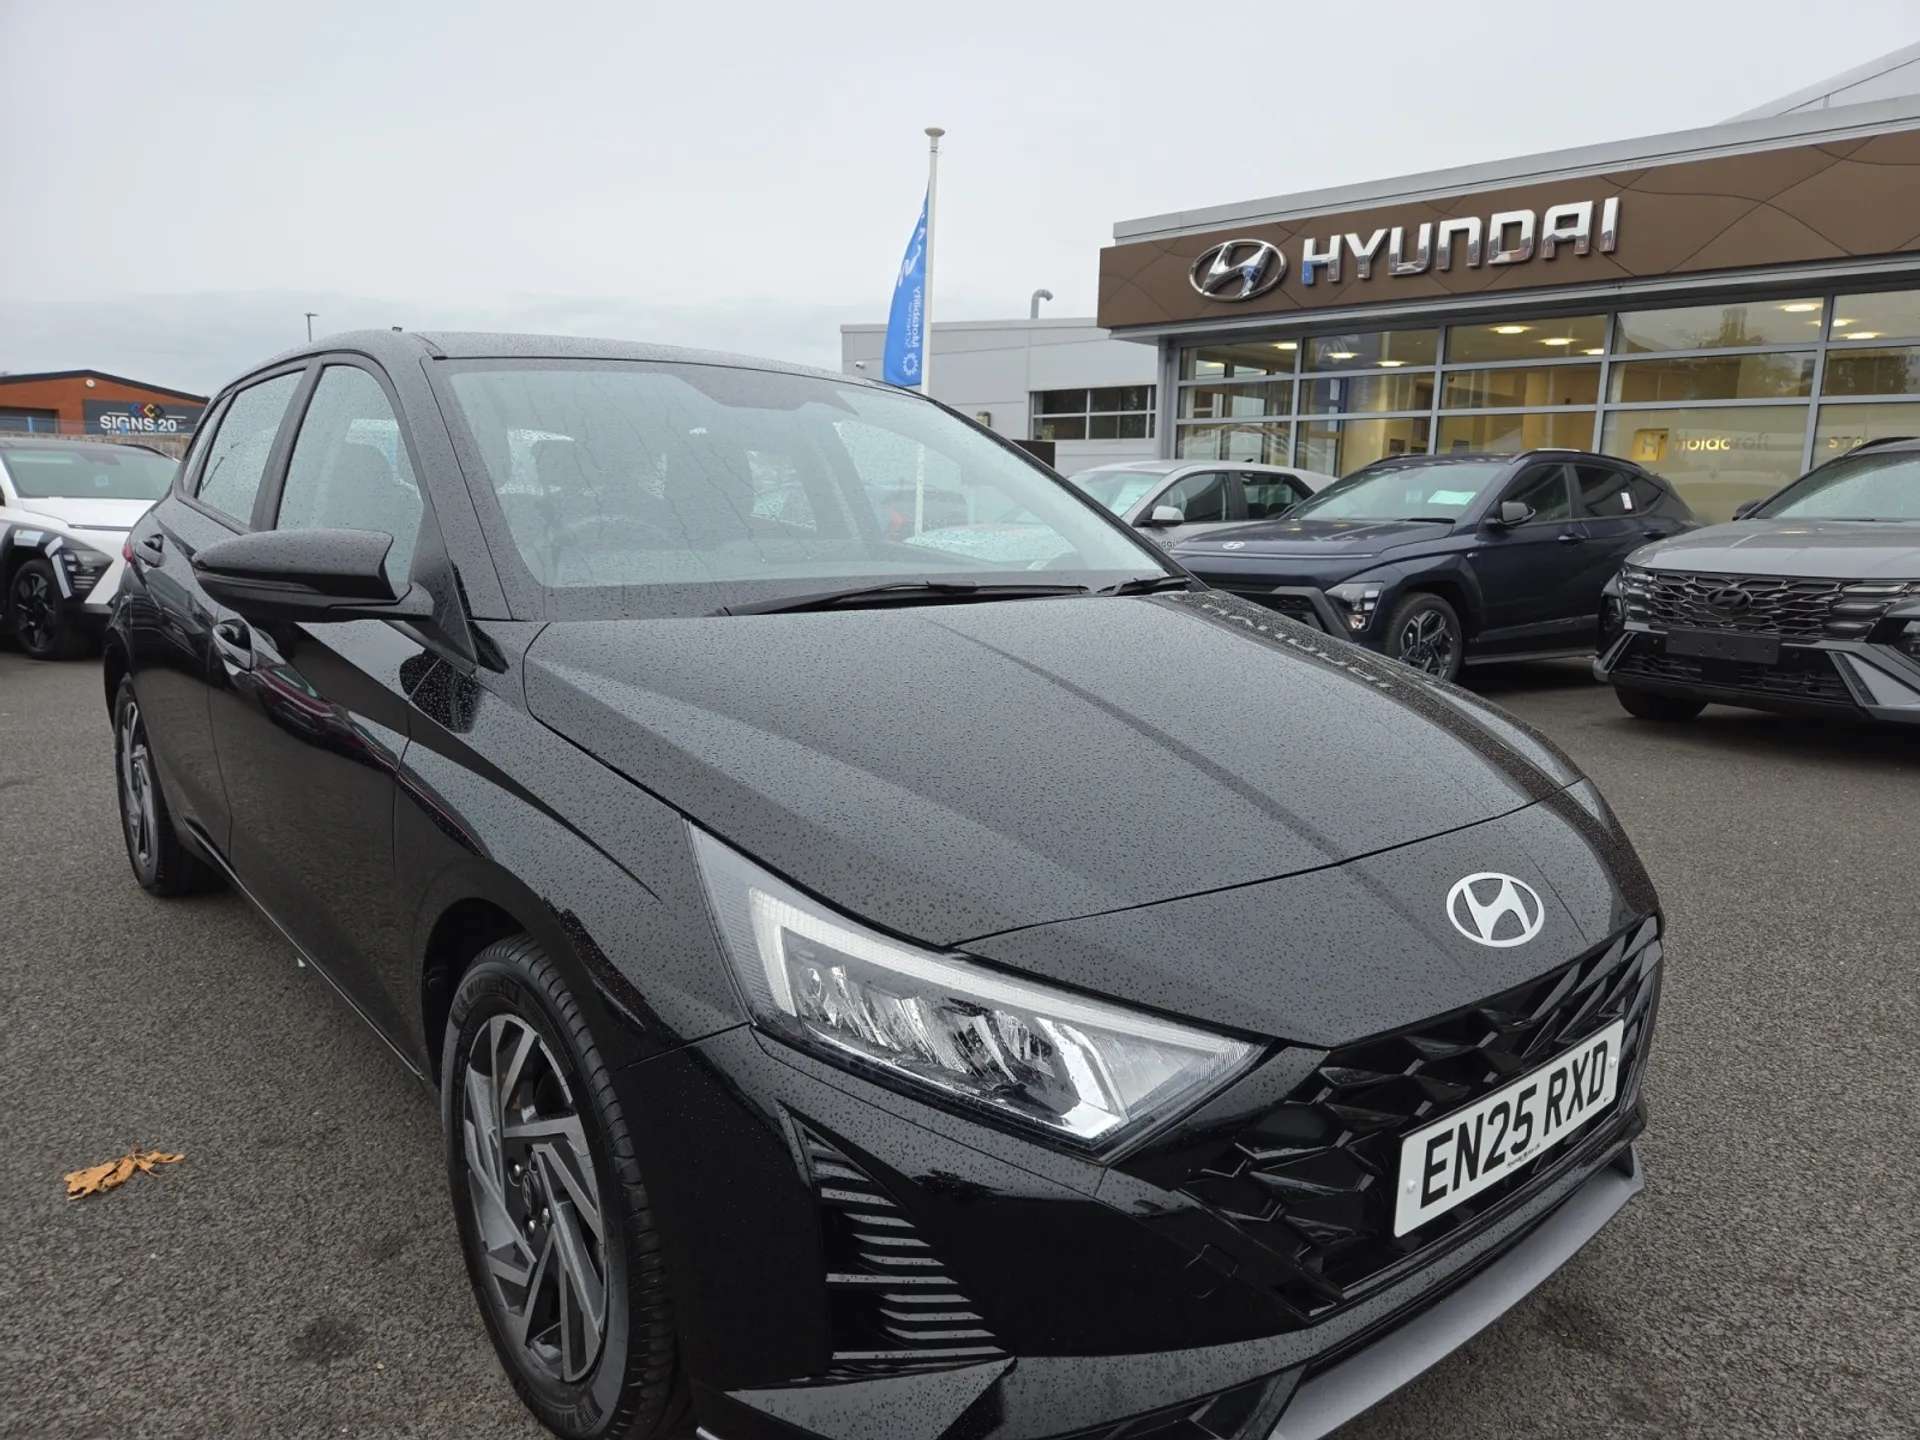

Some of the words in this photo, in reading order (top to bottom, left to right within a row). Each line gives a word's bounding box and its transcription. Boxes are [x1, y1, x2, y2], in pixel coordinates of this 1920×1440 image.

[1303, 197, 1619, 286] HYUNDAI
[99, 415, 155, 432] SIGNS
[1419, 1082, 1538, 1209] EN25
[1543, 1040, 1608, 1137] RXD
